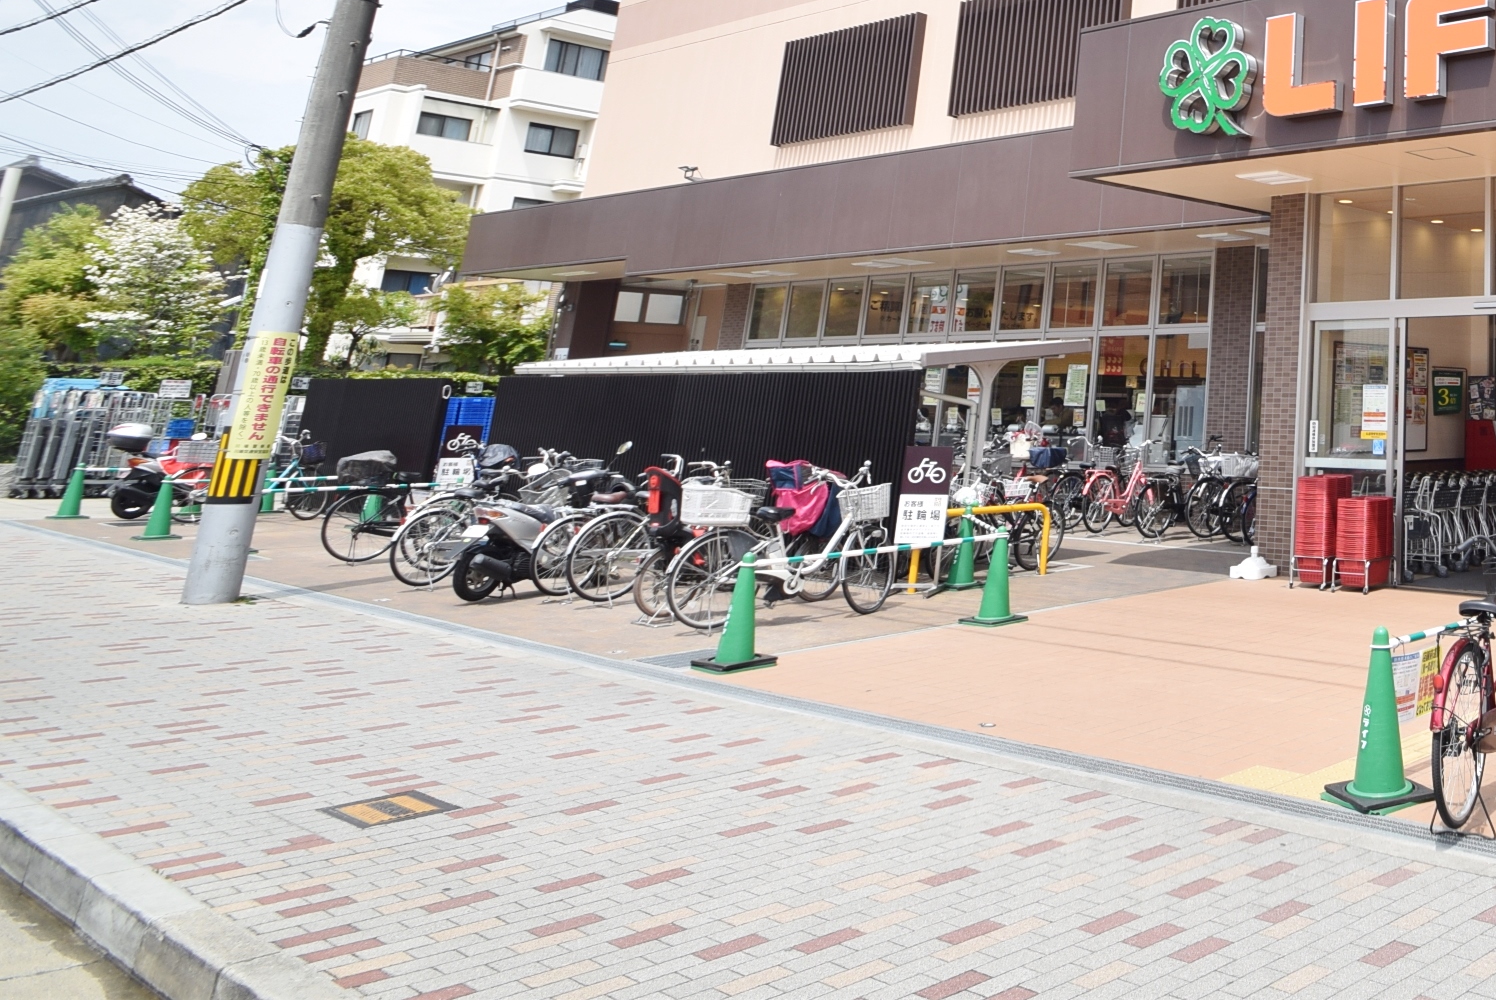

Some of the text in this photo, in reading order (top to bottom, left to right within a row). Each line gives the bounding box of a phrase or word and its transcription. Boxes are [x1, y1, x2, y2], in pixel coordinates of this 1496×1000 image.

[280, 338, 296, 384] この歩道は
[248, 337, 287, 441] 自転車の通行できません
[902, 509, 941, 521] 駐輪場
